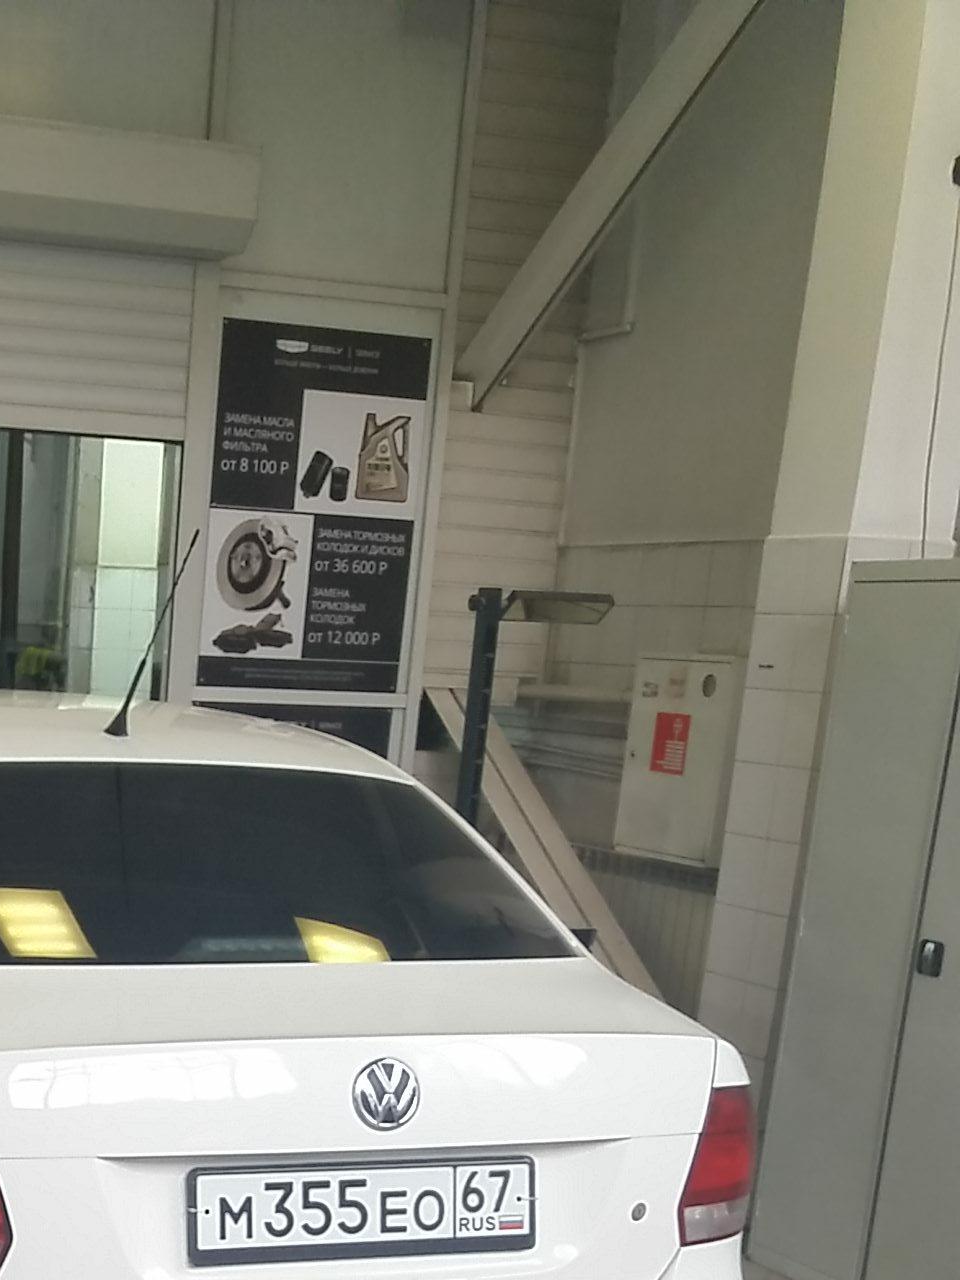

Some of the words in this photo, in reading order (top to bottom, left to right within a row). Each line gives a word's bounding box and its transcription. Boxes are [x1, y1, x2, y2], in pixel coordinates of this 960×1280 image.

[220, 459, 237, 472] от
[240, 457, 249, 473] 8
[253, 459, 278, 474] 100
[314, 560, 330, 573] от
[333, 558, 349, 574] 36
[352, 560, 377, 575] 600
[308, 631, 324, 643] от
[327, 630, 342, 645] 12
[345, 631, 369, 646] 000
[461, 1169, 511, 1213] 67
[458, 1215, 496, 1232] RUS
